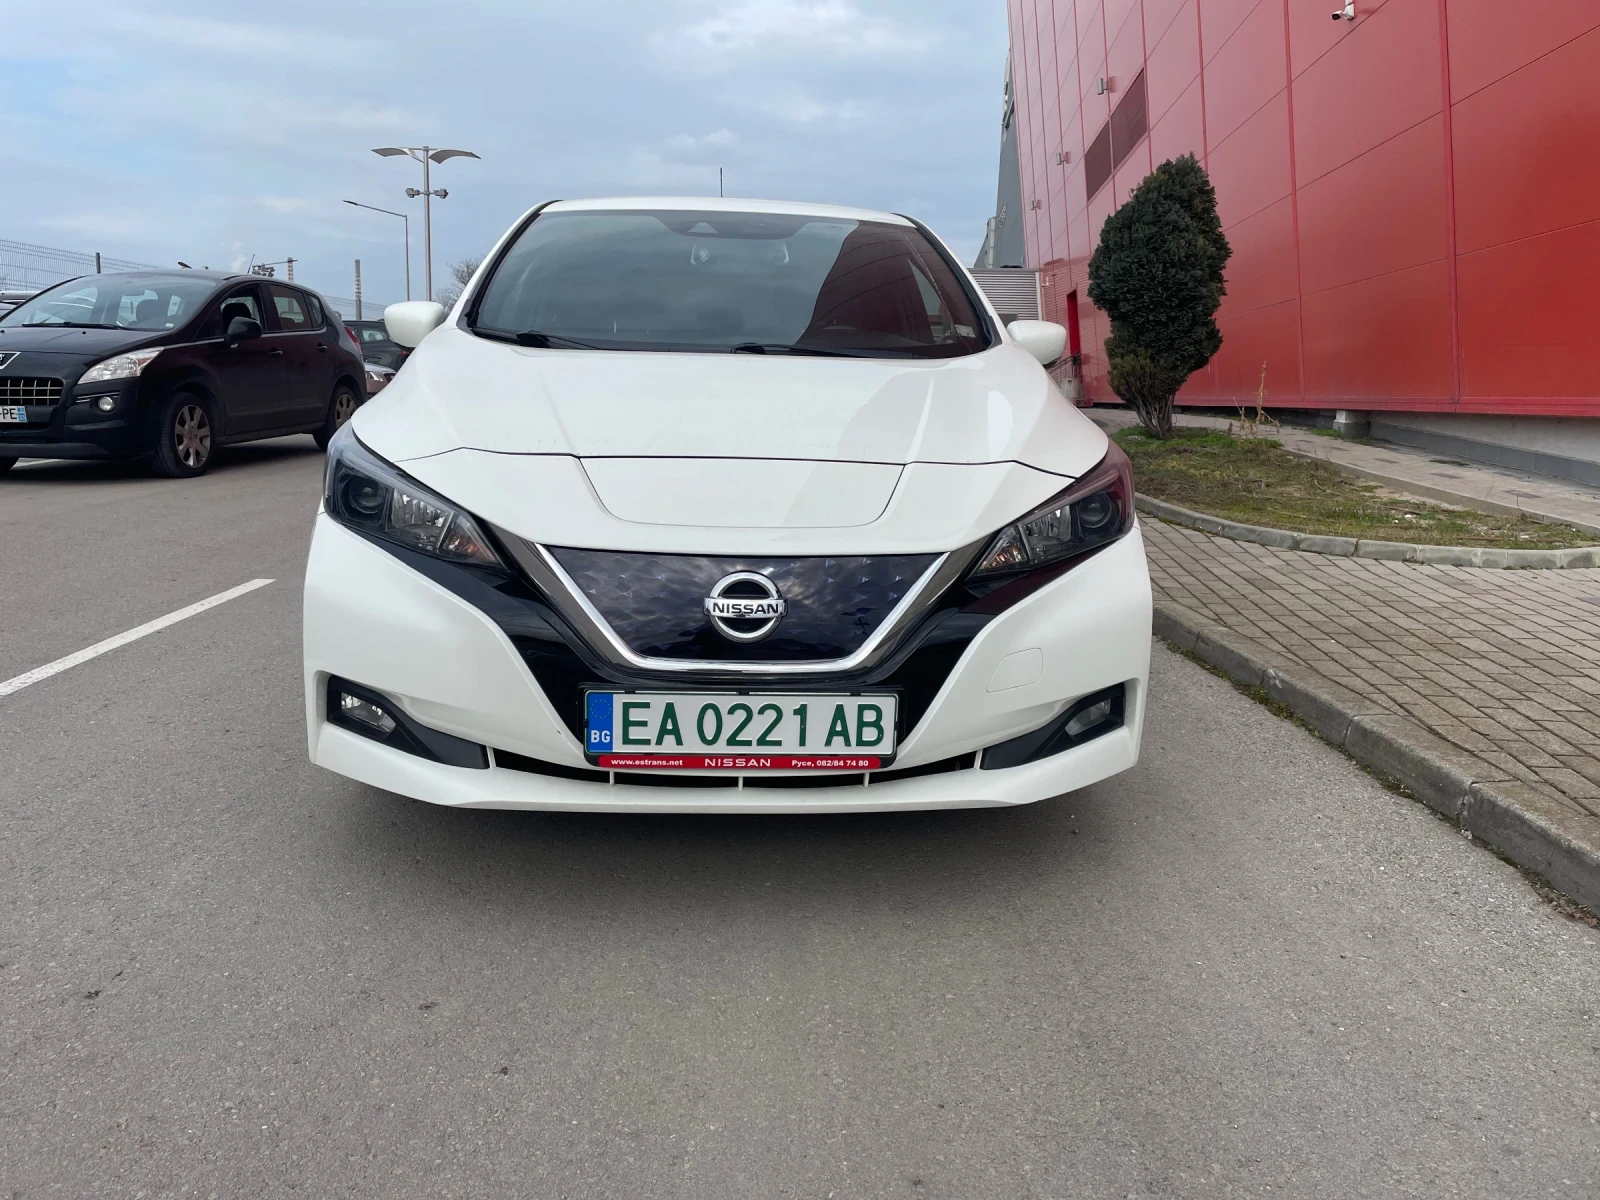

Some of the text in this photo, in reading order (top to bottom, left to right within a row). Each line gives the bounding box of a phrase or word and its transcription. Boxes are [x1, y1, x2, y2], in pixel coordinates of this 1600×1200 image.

[713, 603, 778, 614] NISSAN
[622, 701, 884, 747] EA 0221 AB
[590, 730, 611, 743] BG
[704, 758, 771, 767] NISSAN
